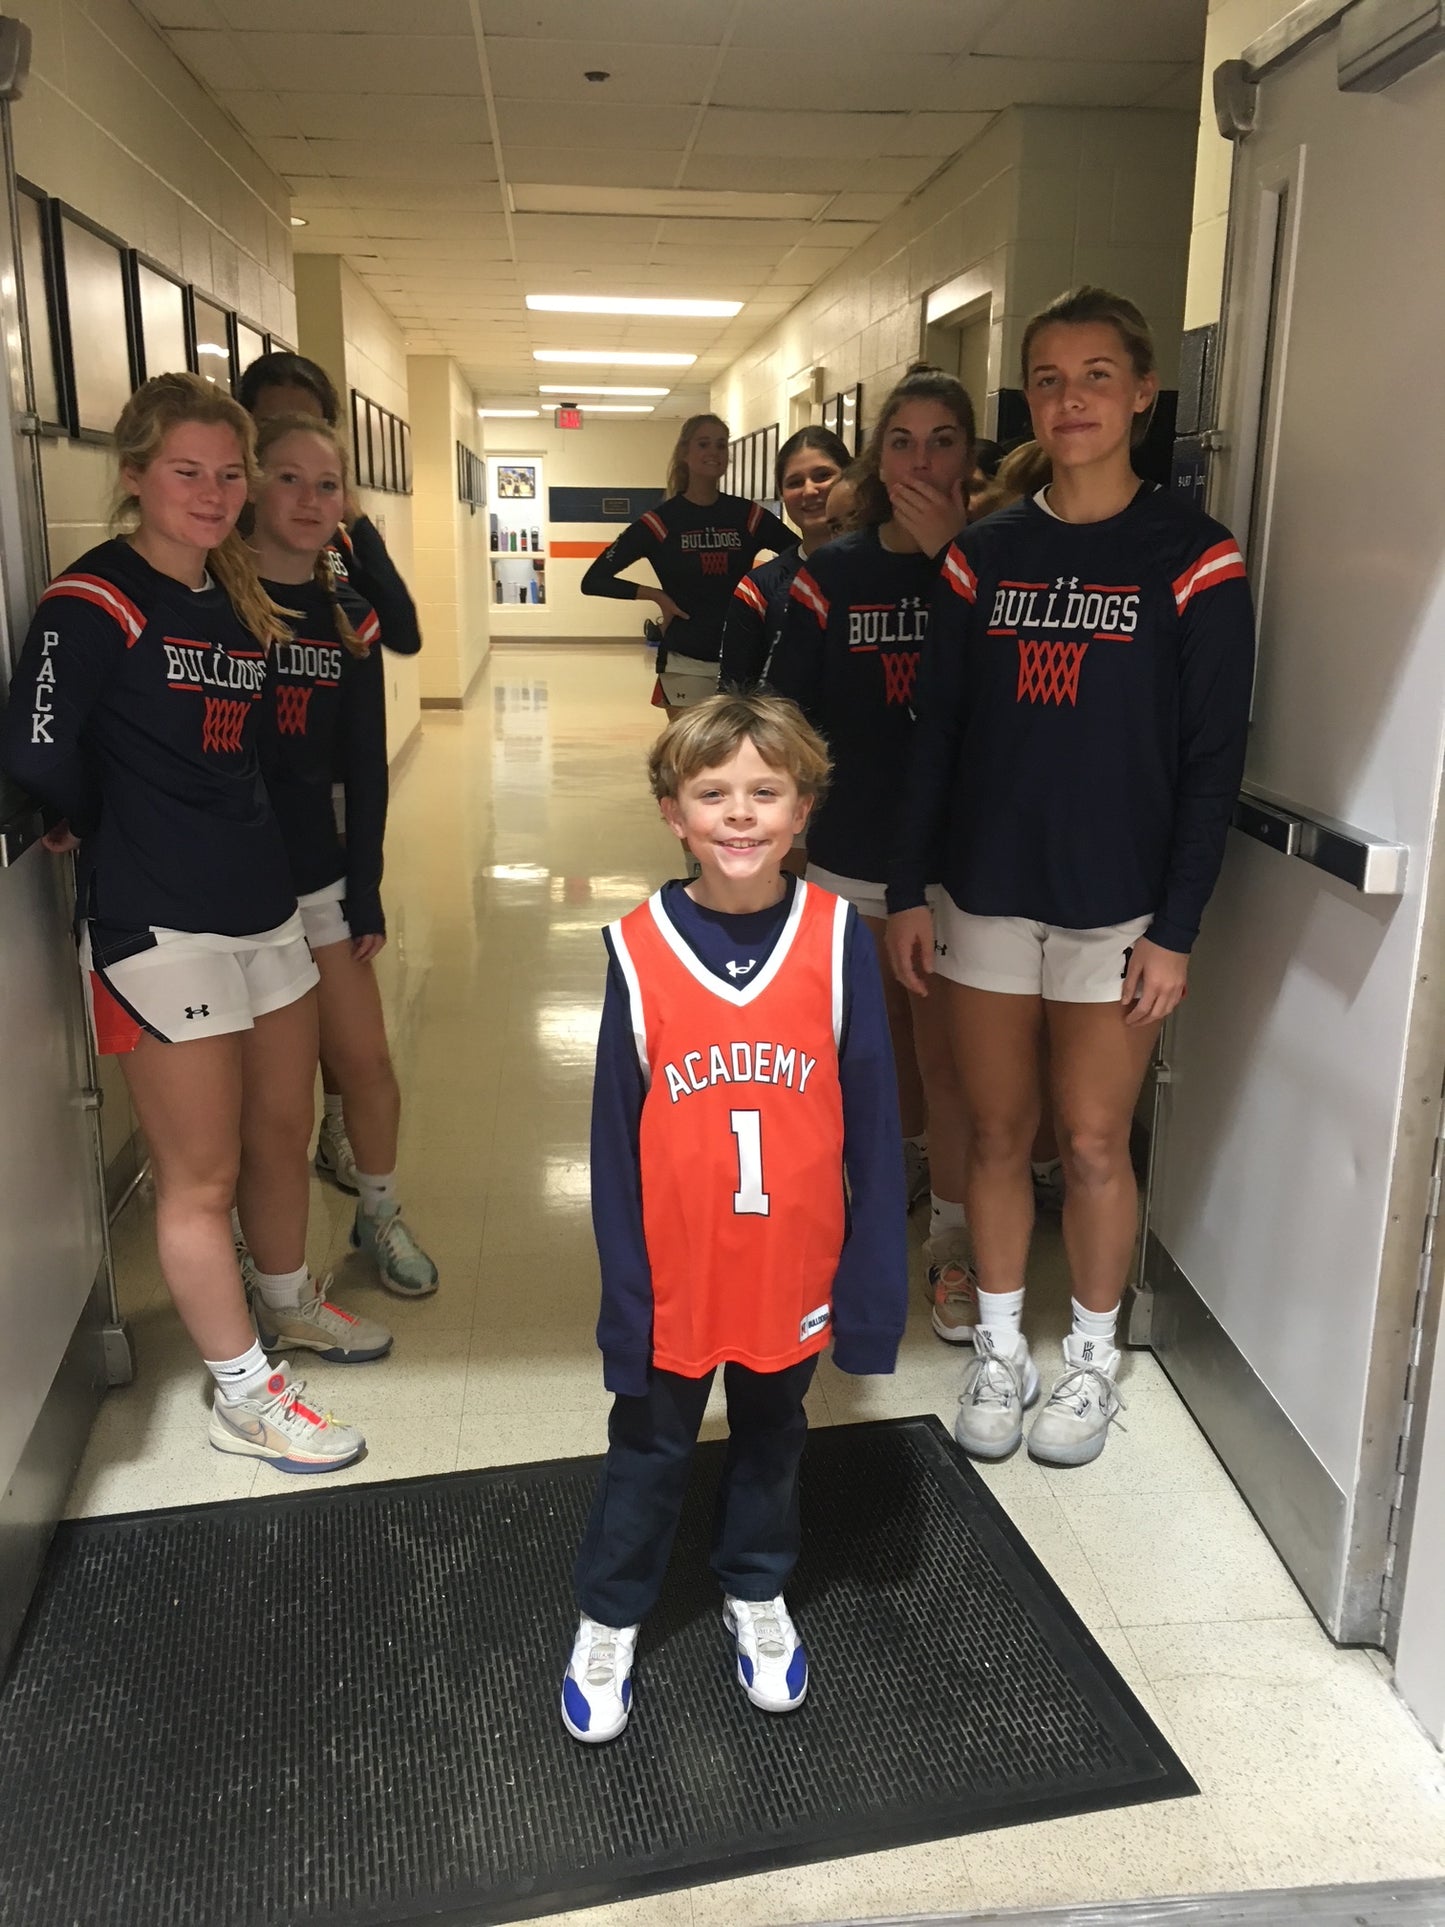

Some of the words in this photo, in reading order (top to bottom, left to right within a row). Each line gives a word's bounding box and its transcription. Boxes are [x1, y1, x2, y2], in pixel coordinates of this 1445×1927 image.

[681, 530, 742, 550] BULLDOGS
[848, 610, 929, 646] BULLD
[989, 589, 1140, 642] BULLDOGS
[30, 630, 60, 744] PACK
[275, 642, 342, 680] LDOGS
[664, 1041, 817, 1105] ACADEMY
[730, 1108, 770, 1217] 1
